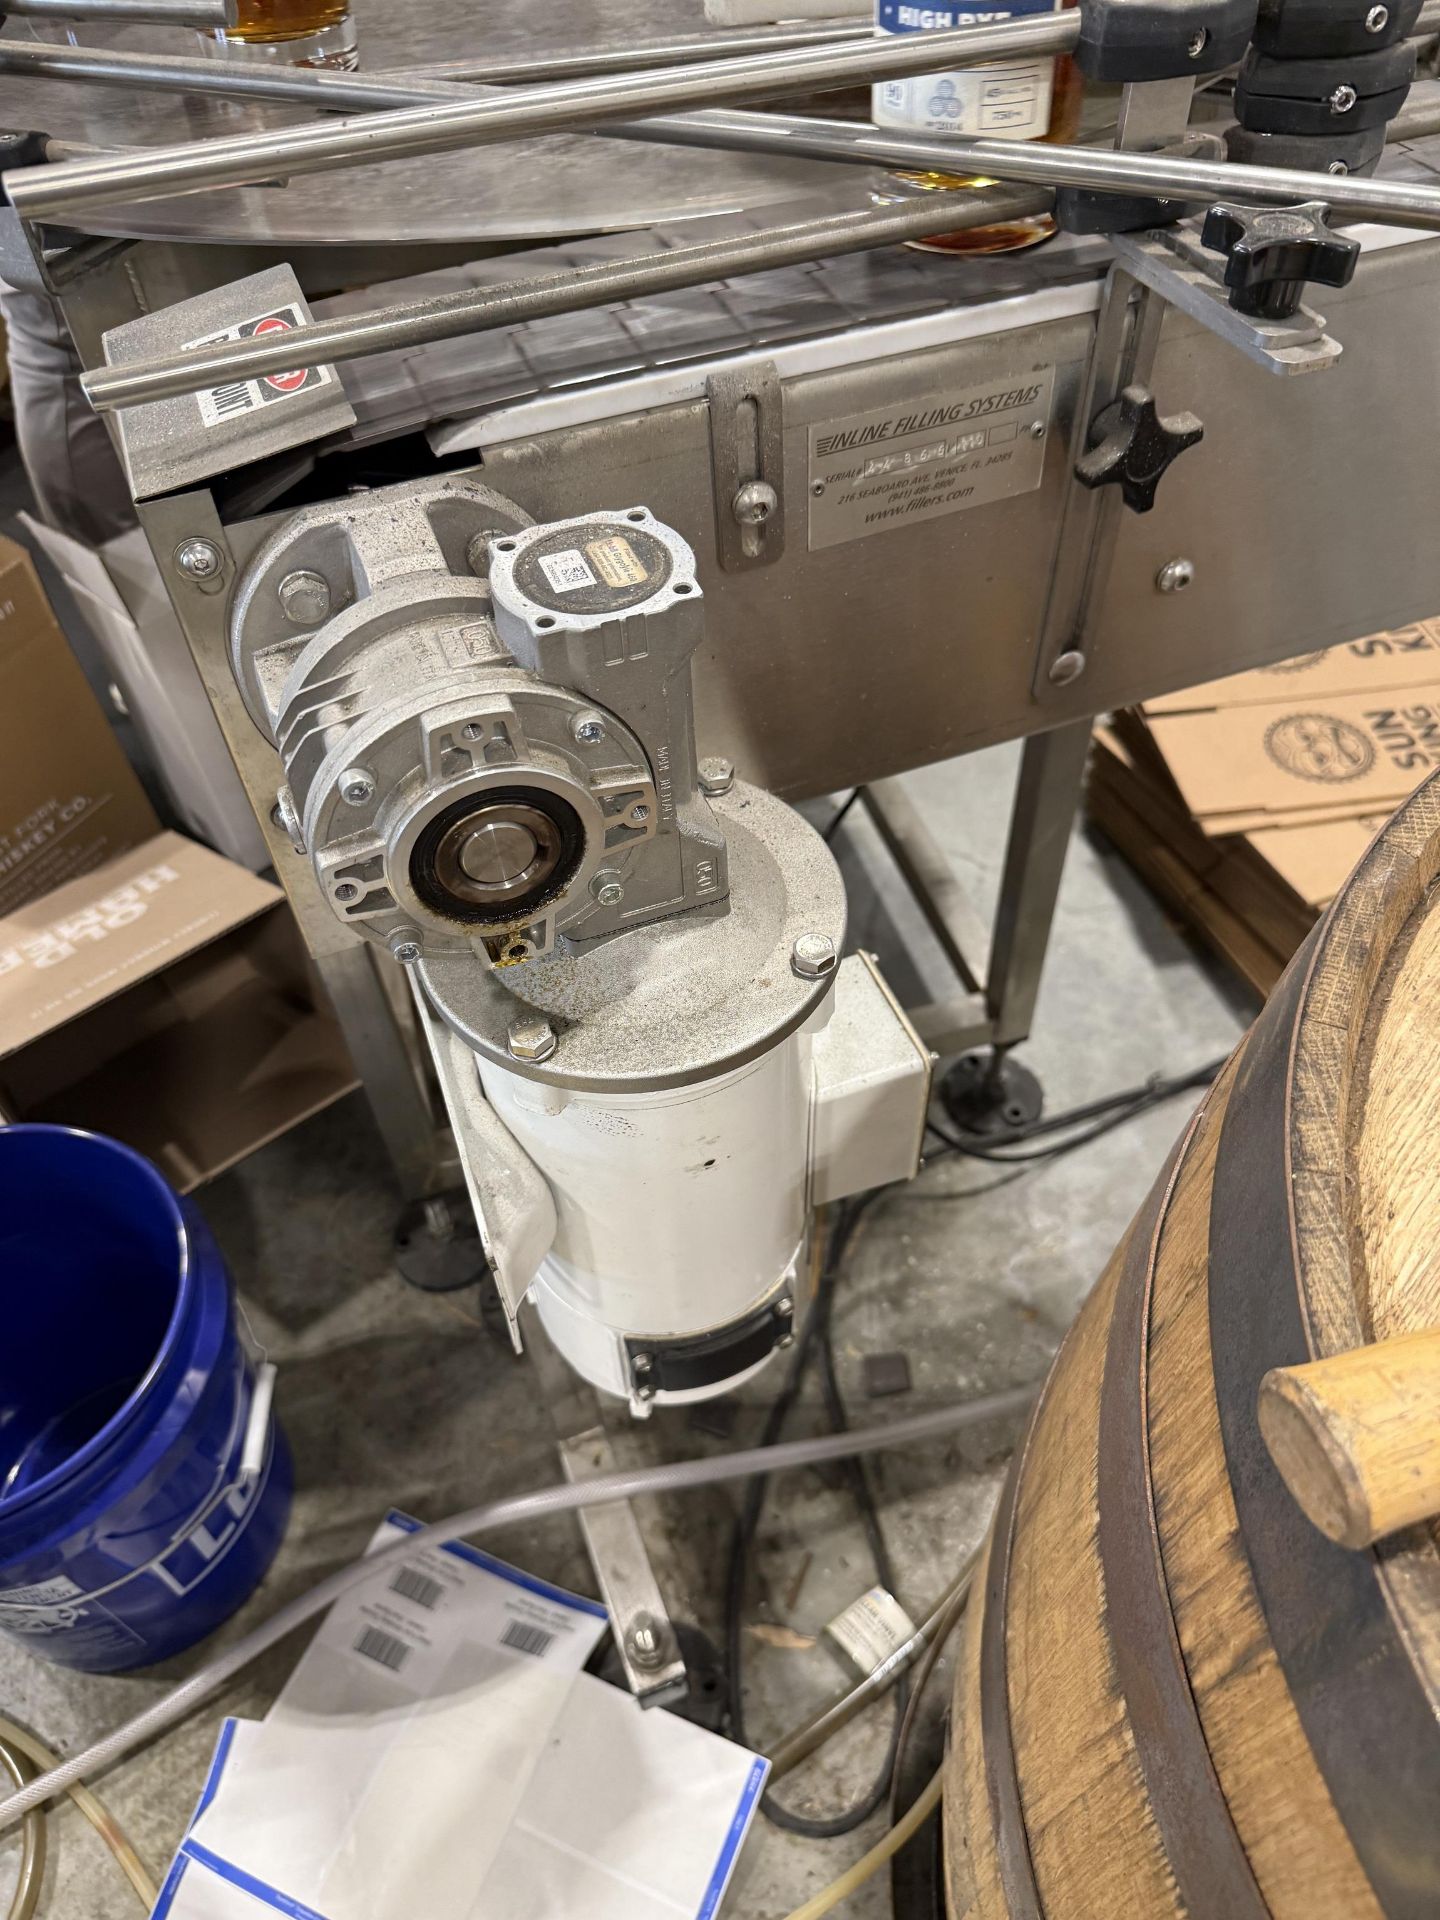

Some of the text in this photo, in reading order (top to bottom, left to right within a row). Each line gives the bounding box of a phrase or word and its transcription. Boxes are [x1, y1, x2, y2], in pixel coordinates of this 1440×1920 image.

[898, 6, 952, 29] HIGH
[211, 381, 254, 416] OINT
[829, 384, 1043, 451] INLINE FILLING SYSTEMS
[837, 493, 856, 505] 216
[858, 479, 909, 500] SEABOARD
[864, 486, 975, 523] www.fillers.com
[1362, 709, 1430, 770] SUN
[34, 901, 148, 969] OLD
